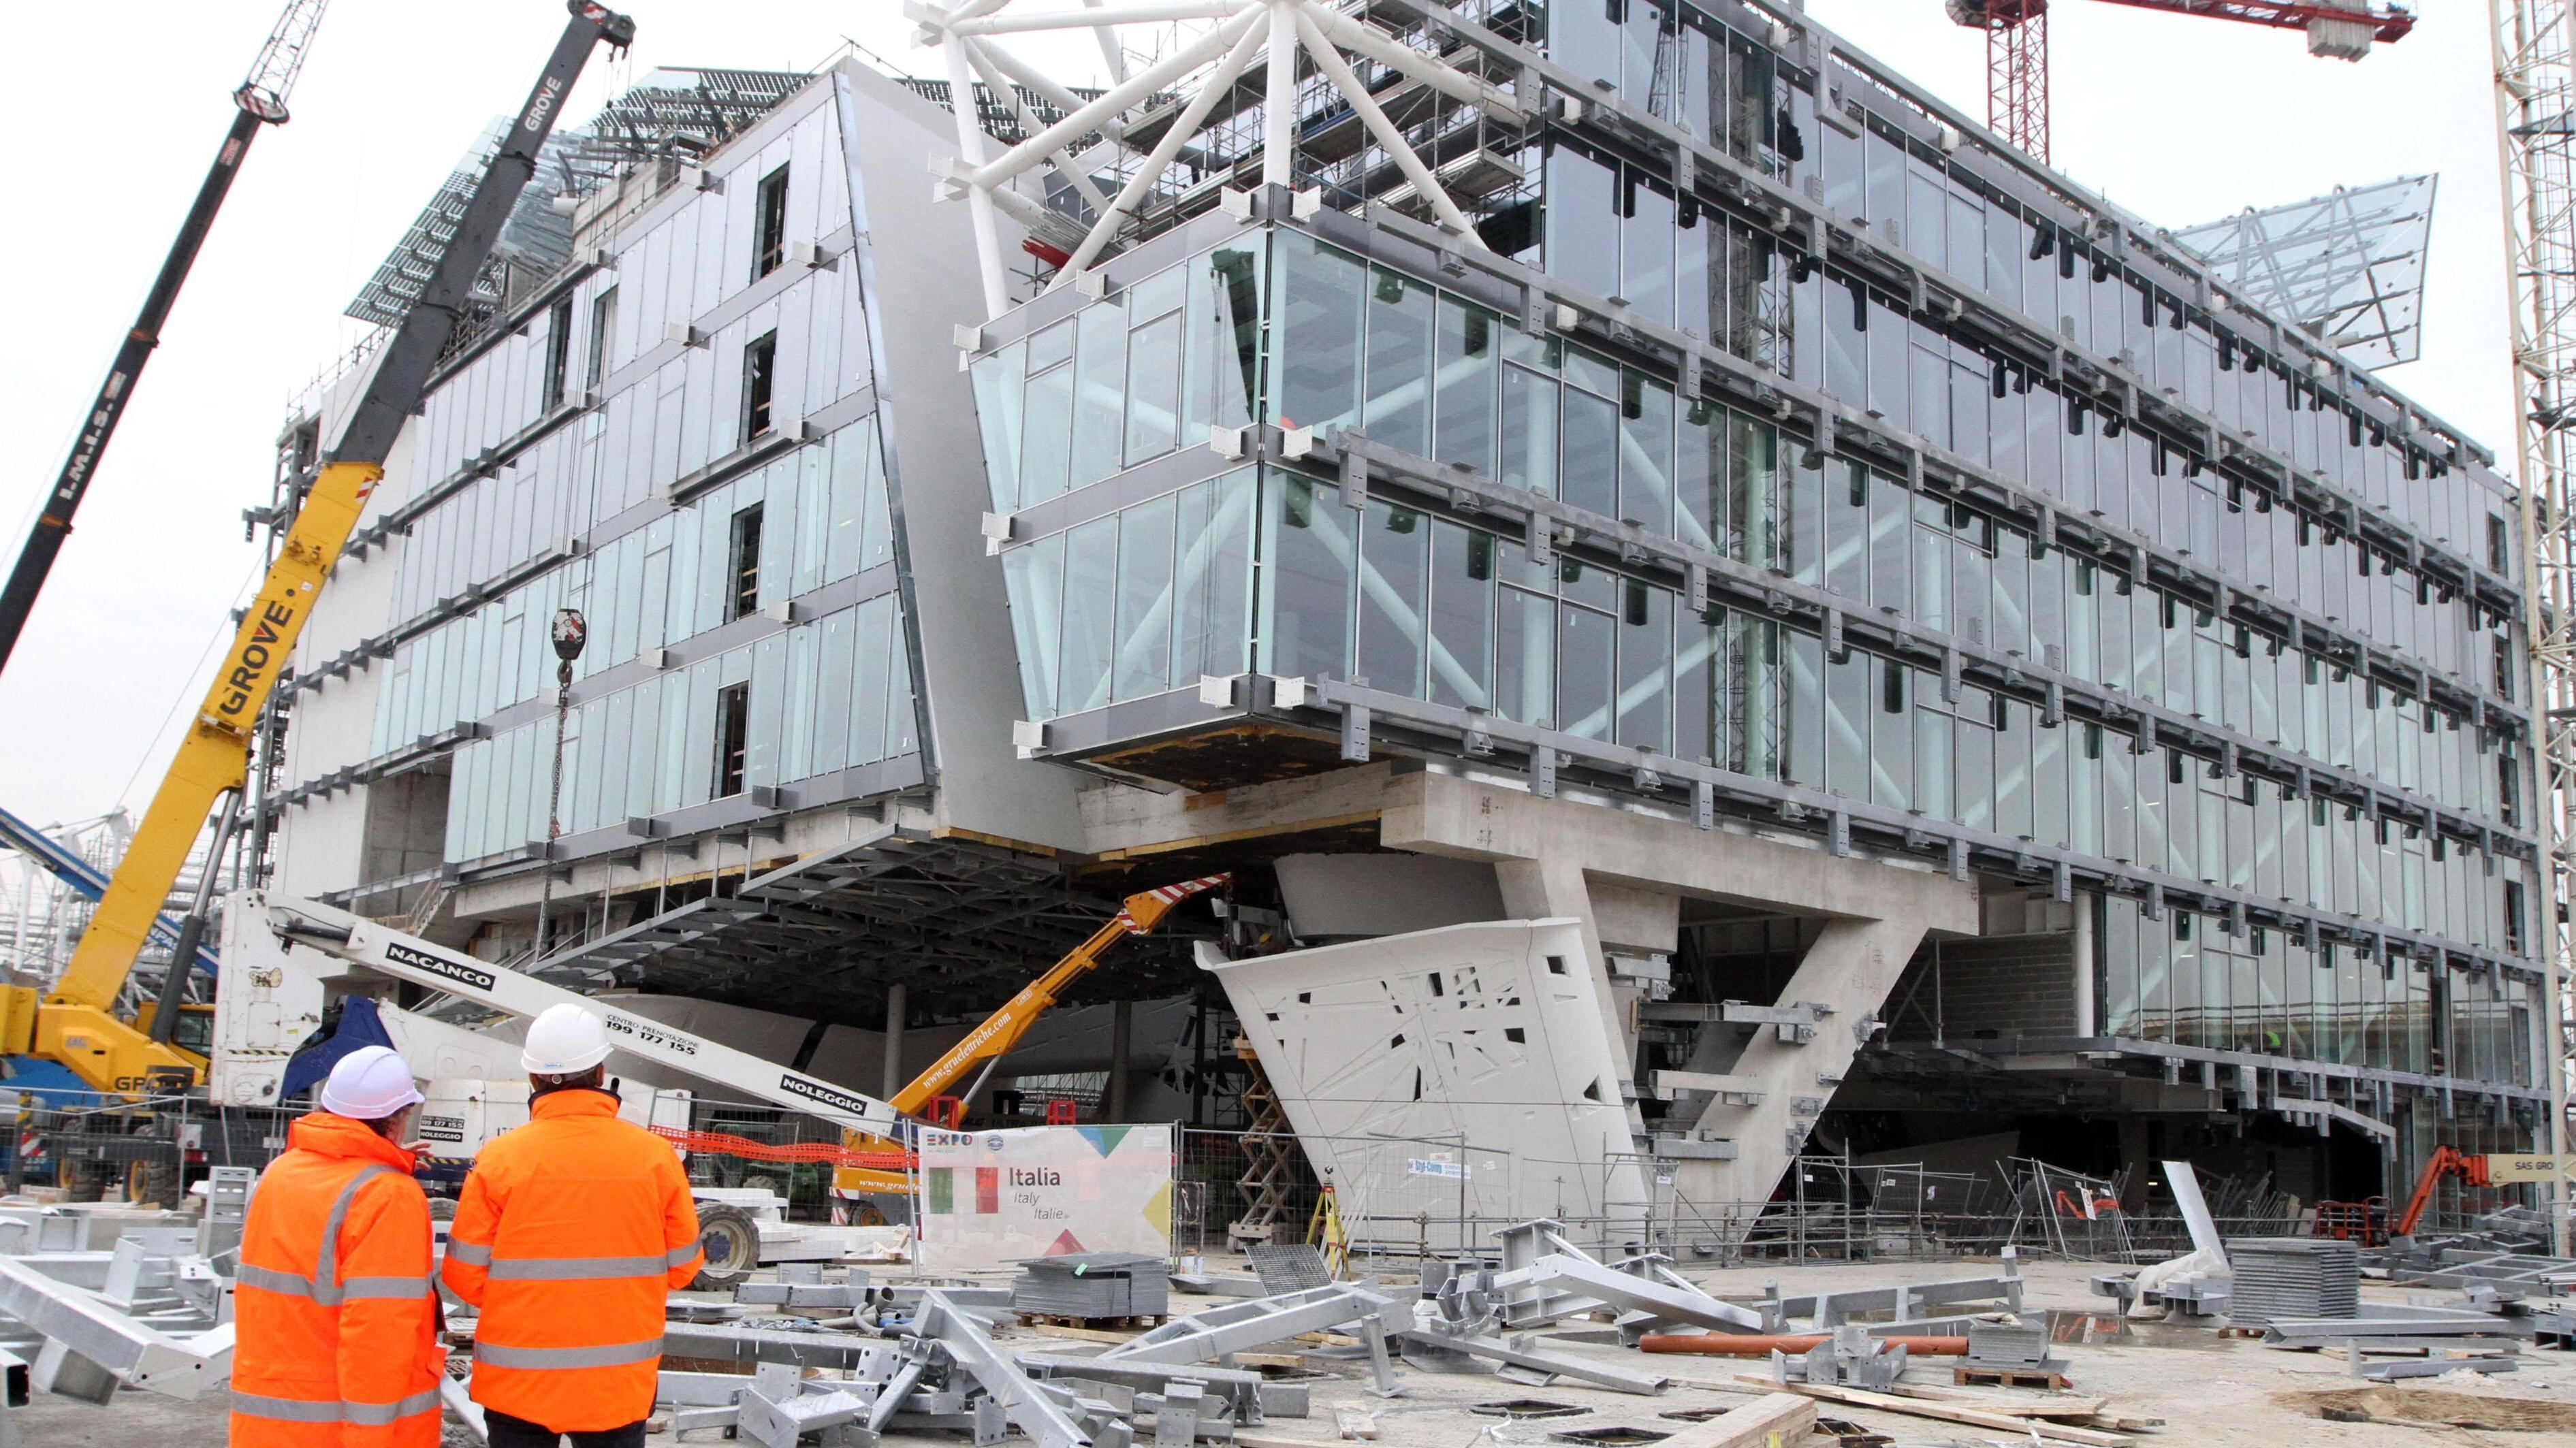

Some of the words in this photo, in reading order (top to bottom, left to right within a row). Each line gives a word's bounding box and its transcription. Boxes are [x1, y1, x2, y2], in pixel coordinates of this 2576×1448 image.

[524, 76, 562, 131] GROVE
[219, 600, 294, 715] GROVE
[389, 947, 491, 986] NACANCO
[605, 1020, 633, 1034] 199
[639, 1031, 663, 1044] 177
[669, 1041, 695, 1055] 155
[607, 1014, 639, 1029] CENTRO
[642, 1025, 699, 1048] PRENOTAZIONE
[923, 1012, 1011, 1088] www.gruelettriche.com
[782, 1078, 863, 1112] NOLEGGIO
[420, 1131, 462, 1140] NOLEGGIO
[927, 1133, 973, 1146] EXPO
[1009, 1167, 1061, 1186] Italia
[2515, 1161, 2532, 1170] SAS
[2536, 1161, 2554, 1170] GRO
[1014, 1192, 1040, 1206] Italy
[1034, 1208, 1064, 1220] Italie
